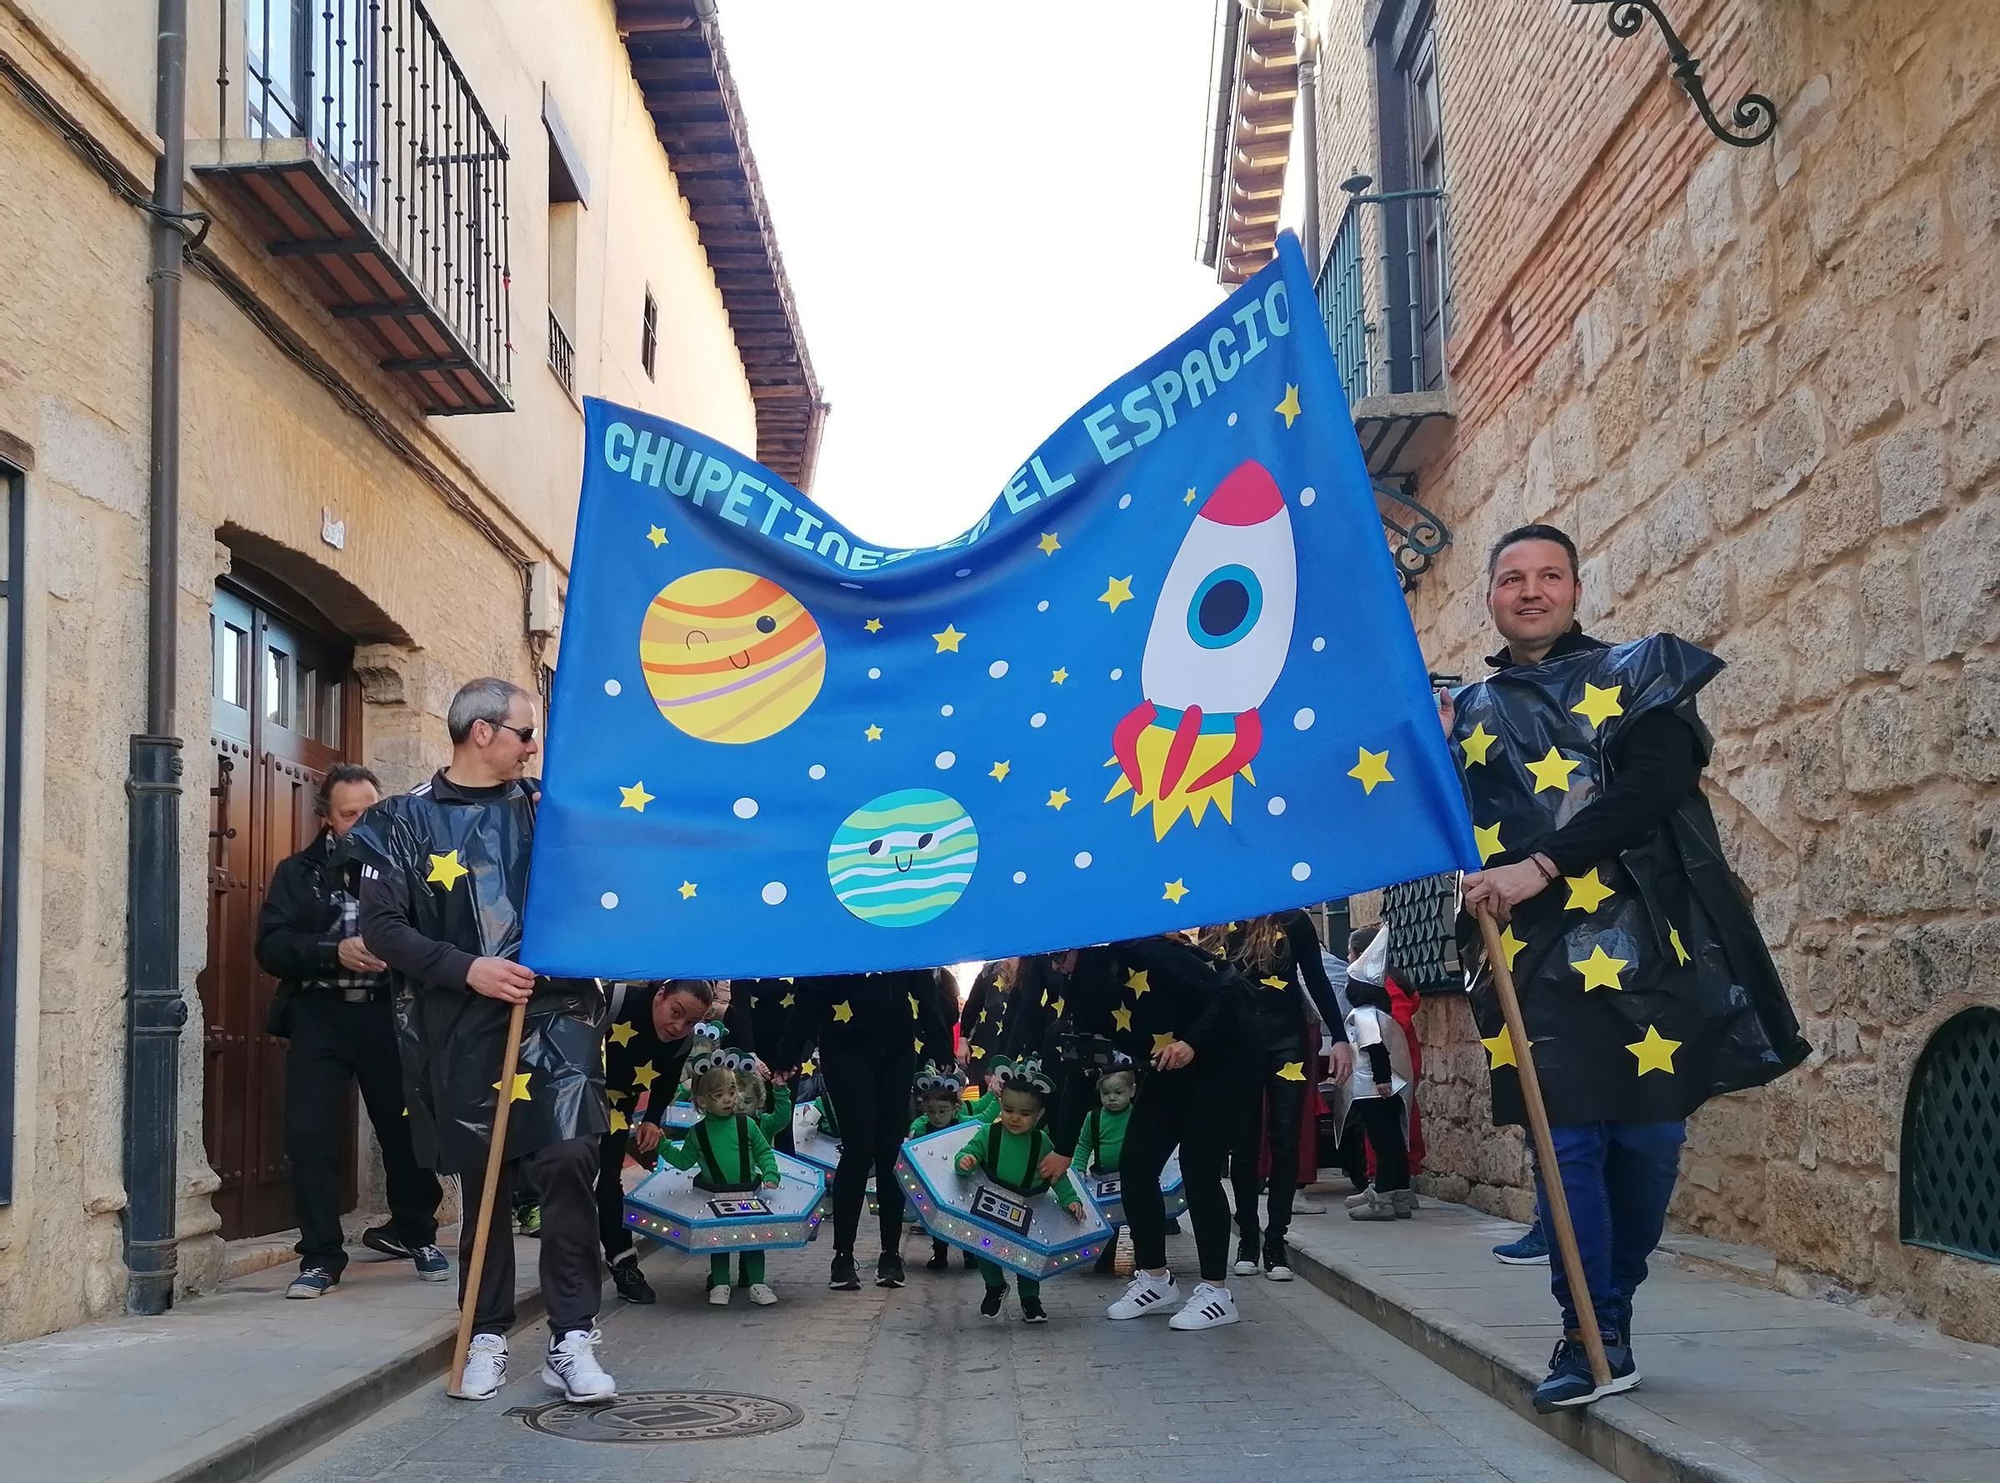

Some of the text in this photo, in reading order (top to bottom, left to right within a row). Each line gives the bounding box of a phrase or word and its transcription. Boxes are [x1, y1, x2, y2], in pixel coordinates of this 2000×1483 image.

[605, 422, 917, 571] CHUPETINES
[1003, 455, 1077, 515] EL
[1083, 280, 1291, 465] ESPACIO
